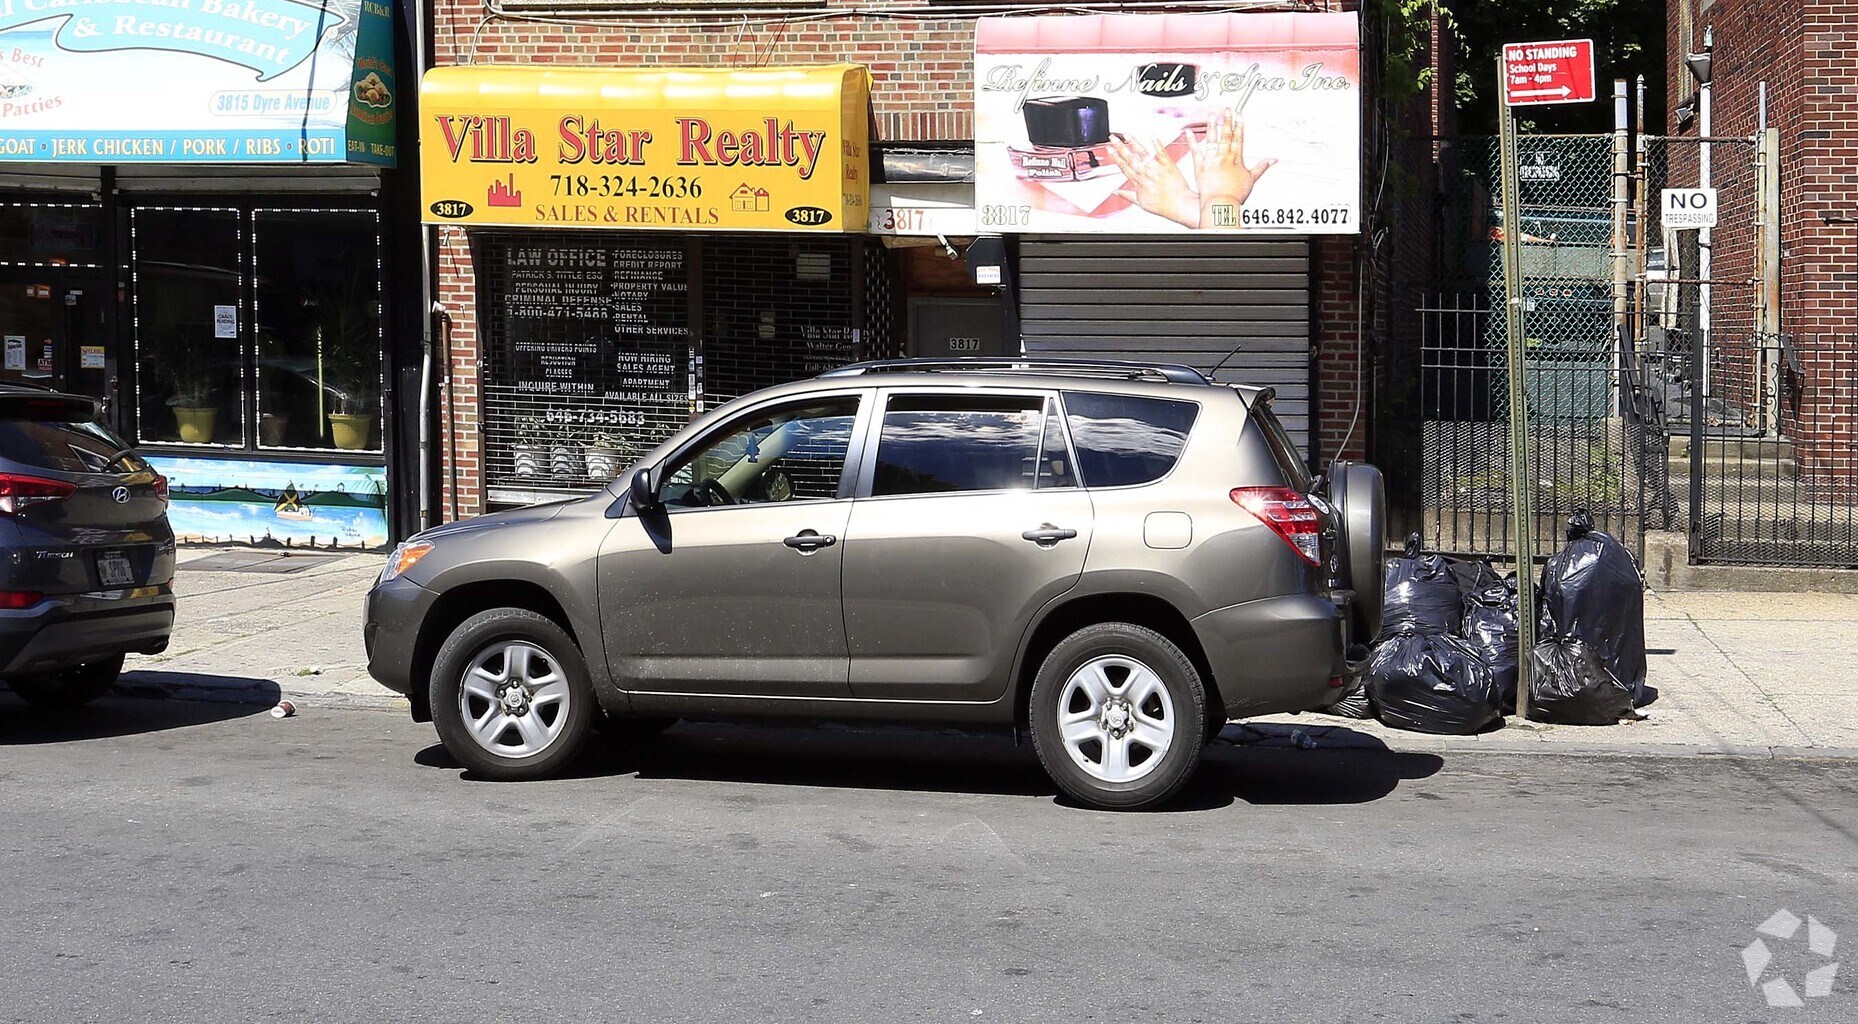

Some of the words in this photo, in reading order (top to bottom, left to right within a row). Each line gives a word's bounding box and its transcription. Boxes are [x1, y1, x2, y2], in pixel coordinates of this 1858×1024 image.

[73, 17, 103, 38] &
[112, 15, 290, 64] Restaurant
[1508, 49, 1523, 61] NO
[1525, 46, 1577, 60] STANDING
[1509, 64, 1536, 73] School
[1538, 63, 1557, 73] Days
[1510, 75, 1527, 84] 7am
[1534, 74, 1552, 85] 4pm
[1103, 62, 1188, 94] Nails
[1194, 72, 1220, 101] &
[1219, 63, 1285, 113] Spa
[1289, 62, 1350, 91] Inc.
[217, 94, 249, 111] 3815
[253, 93, 281, 115] Dyre
[51, 138, 88, 158] JERK
[93, 138, 164, 156] CHICKEN
[183, 138, 229, 156] PORK
[246, 138, 281, 156] RIBS
[298, 137, 336, 156] ROTI
[434, 114, 539, 166] Villa
[557, 114, 652, 166] Star
[675, 115, 826, 179] Realty
[549, 175, 702, 199] 718-324-2636
[1671, 193, 1707, 209] NO
[436, 203, 467, 217] 3817
[535, 204, 597, 222] SALES
[603, 206, 618, 223] &
[627, 206, 719, 224] RENTALS
[791, 208, 825, 223] 3817
[883, 208, 924, 231] 3817
[981, 205, 1032, 225] 3817
[1212, 205, 1236, 226] TEL
[1242, 209, 1348, 224] 646.842.4077
[1665, 213, 1714, 224] TRESPASSING
[507, 248, 541, 266] LAW
[547, 249, 606, 267] OFFICE
[614, 250, 683, 260] FORECLOSURES
[613, 260, 645, 268] CREDIT
[648, 261, 682, 269] REPORT
[614, 270, 663, 280] REFINANCE
[515, 282, 562, 293] PERSONAL
[565, 283, 599, 294] INJURY
[613, 282, 658, 291] PROPERTY
[505, 294, 558, 305] CRIMINAL
[614, 302, 642, 312] SALES
[614, 324, 644, 334] OTHER
[646, 326, 689, 335] SERVICES
[950, 338, 979, 350] 3817
[618, 352, 638, 363] NOW
[640, 353, 671, 364] HIRING
[616, 363, 643, 373] SALES
[646, 364, 675, 375] AGENT
[518, 381, 557, 393] INQUIRE
[559, 382, 594, 394] WITHIN
[622, 378, 670, 389] APARTMENT
[604, 391, 647, 402] AVAILABLE
[649, 392, 664, 403] ALL
[666, 394, 689, 405] SIZES
